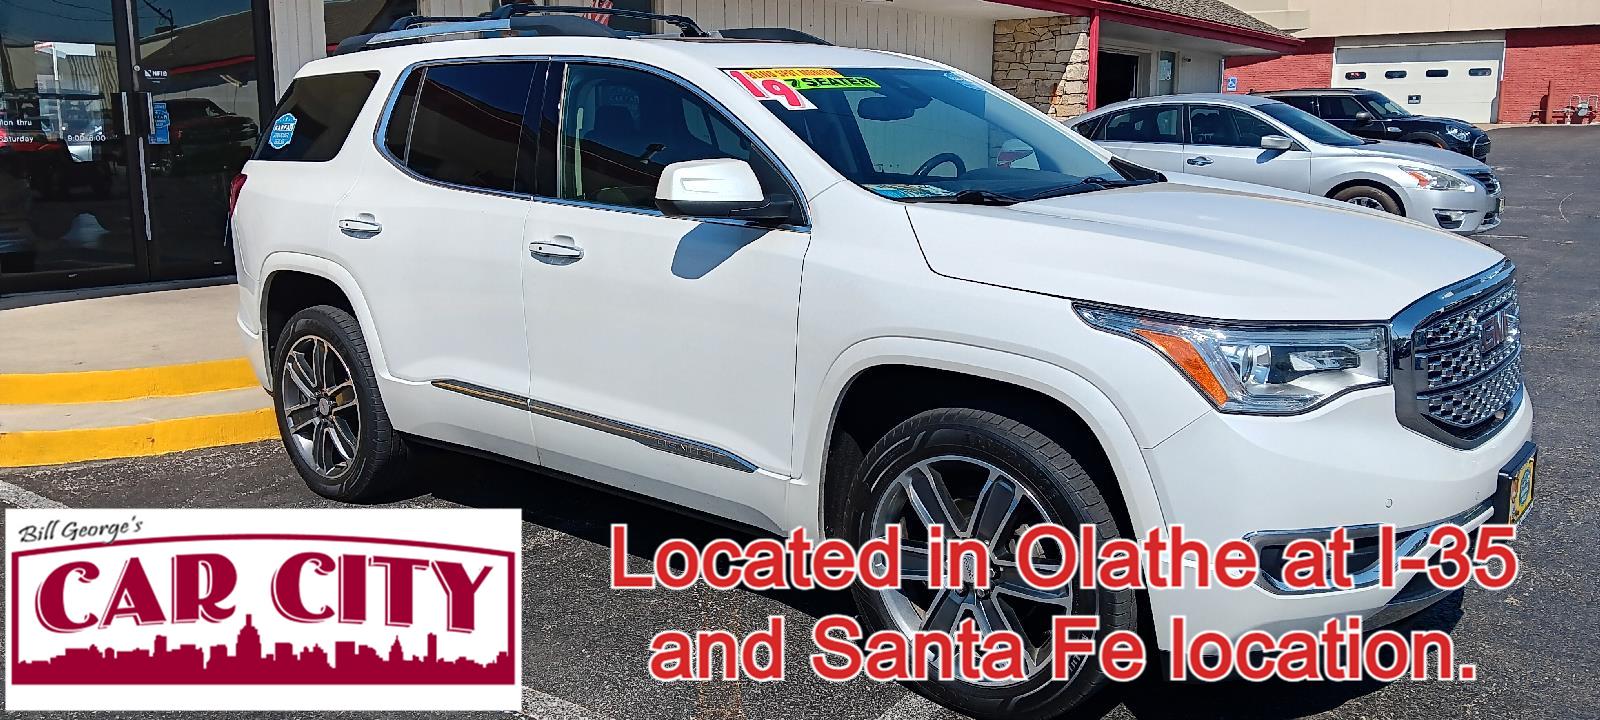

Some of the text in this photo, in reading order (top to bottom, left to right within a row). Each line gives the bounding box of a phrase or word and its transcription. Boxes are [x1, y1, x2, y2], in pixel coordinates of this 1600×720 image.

[783, 77, 871, 88] 7 SEATER
[730, 71, 802, 107] 19
[16, 118, 33, 126] thru
